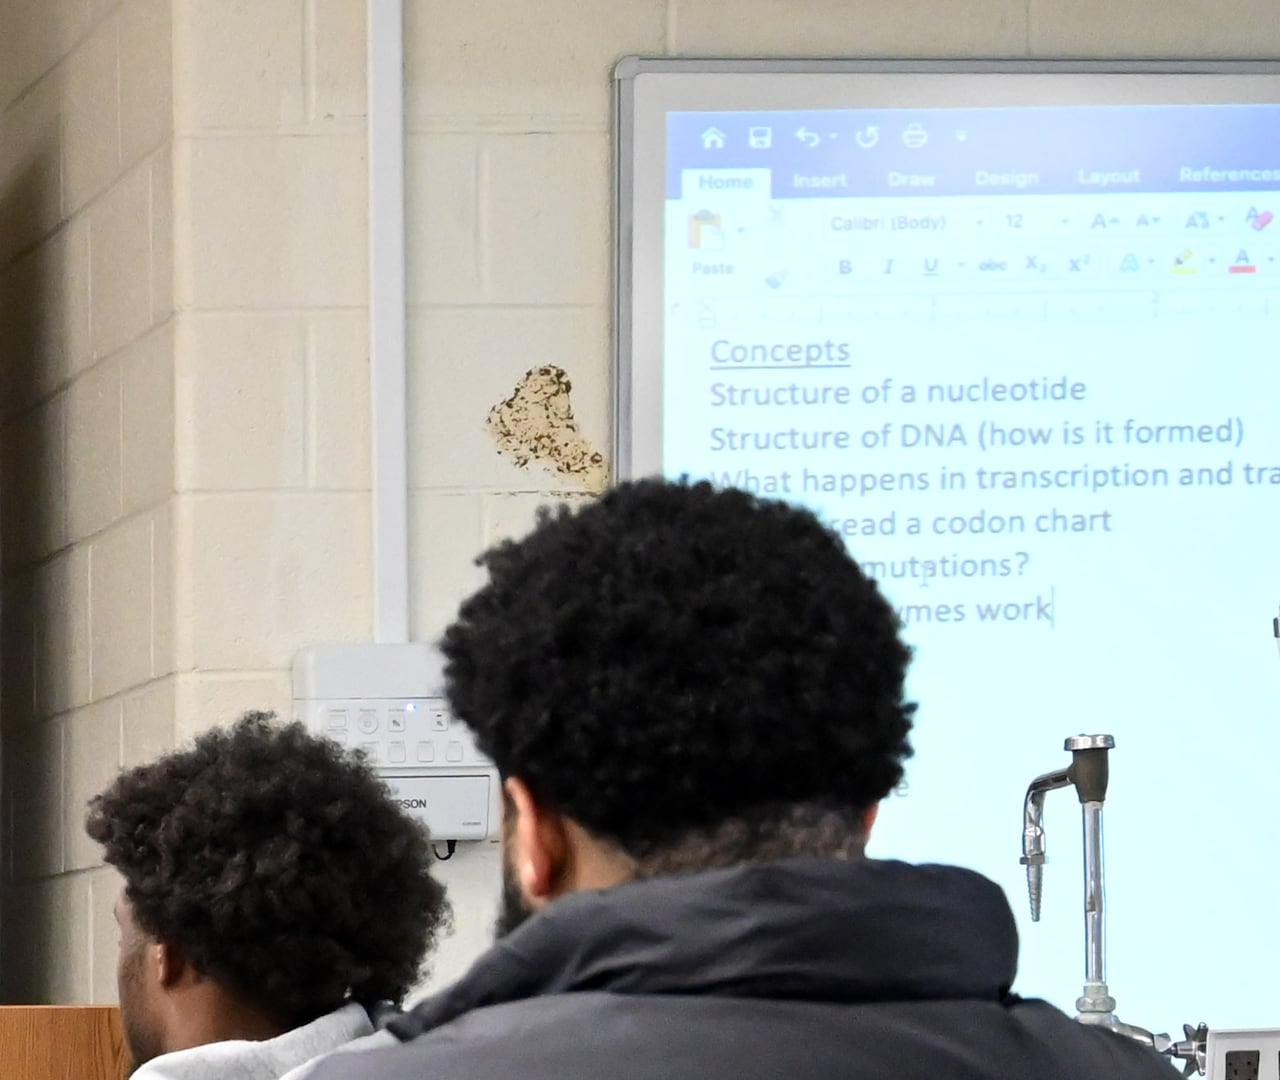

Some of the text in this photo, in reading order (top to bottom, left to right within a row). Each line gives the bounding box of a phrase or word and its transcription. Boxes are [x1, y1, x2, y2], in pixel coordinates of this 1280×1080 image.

[699, 166, 1280, 189] Home Insert Draw Design Layout References
[831, 215, 884, 231] Calibri
[891, 215, 946, 232] (Body)
[1005, 213, 1023, 228] 12
[692, 261, 734, 275] Paste
[710, 339, 851, 367] Concepts
[710, 375, 1088, 406] Structure of a nucleotide
[710, 416, 1245, 451] Structure of DNA (how is it formed)
[710, 460, 1280, 497] What happens in transcription and tra
[906, 516, 921, 535] a
[932, 508, 1026, 535] codon
[1035, 507, 1112, 533] chart
[859, 551, 1030, 579] mutations?
[976, 595, 1053, 622] work
